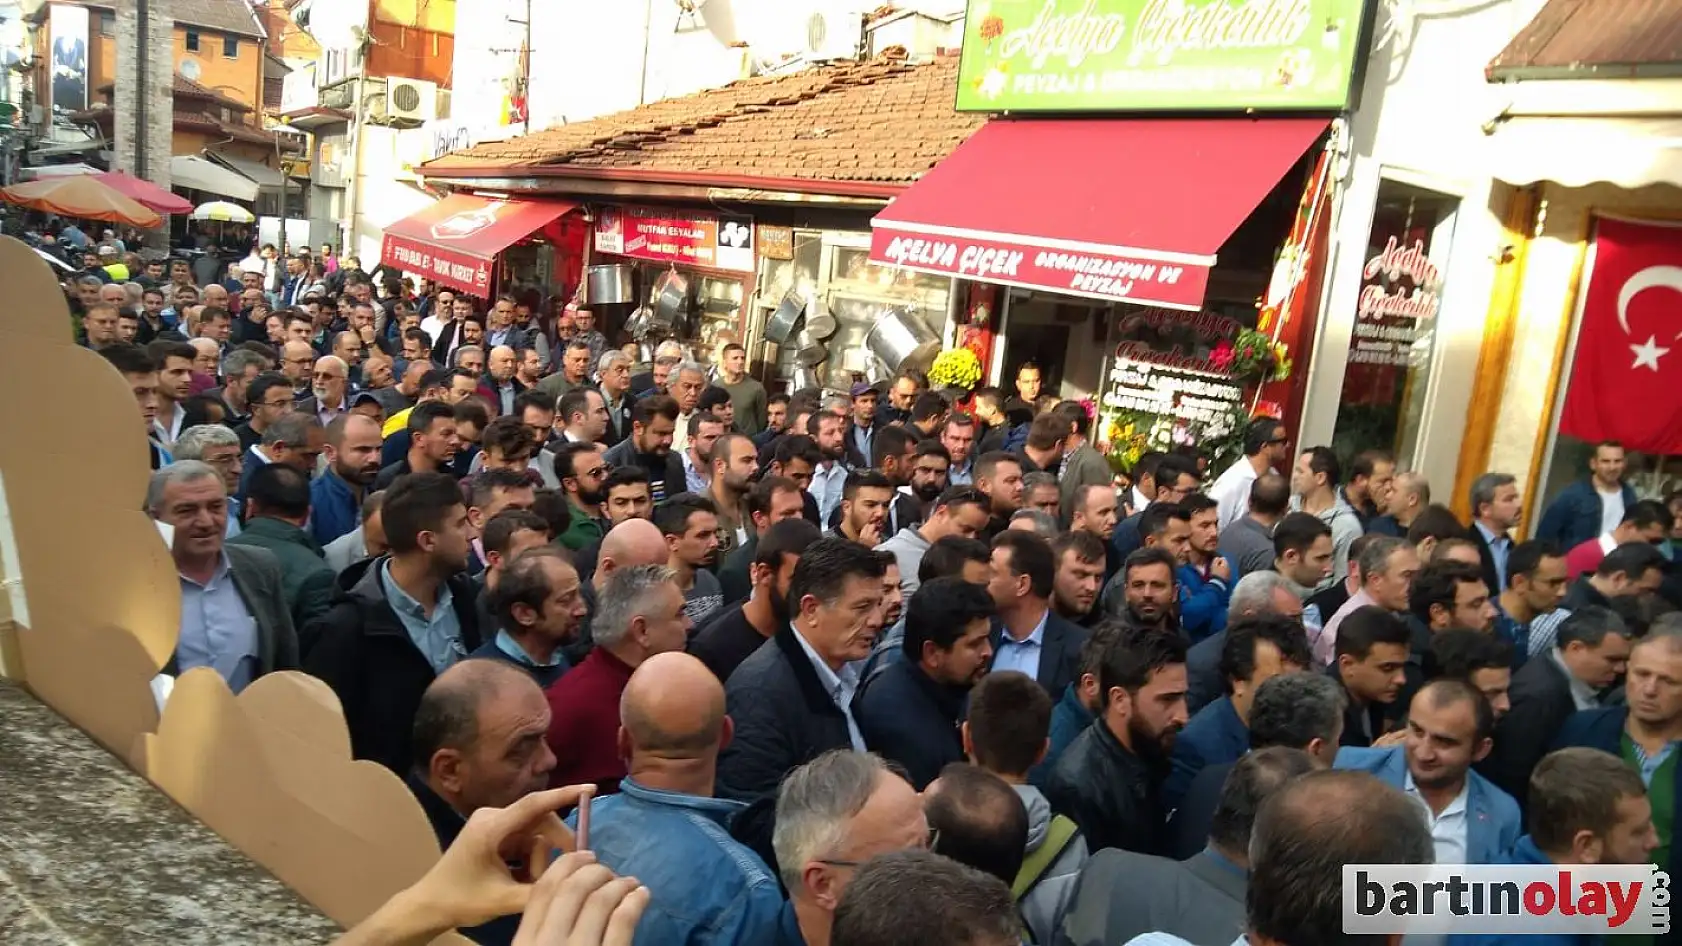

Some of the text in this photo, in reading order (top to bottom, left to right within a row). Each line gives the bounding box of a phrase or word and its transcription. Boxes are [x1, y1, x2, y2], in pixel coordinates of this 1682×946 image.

[885, 236, 957, 267] AÇELYA
[1156, 266, 1183, 284] VE
[1069, 273, 1134, 296] PEYZAJ
